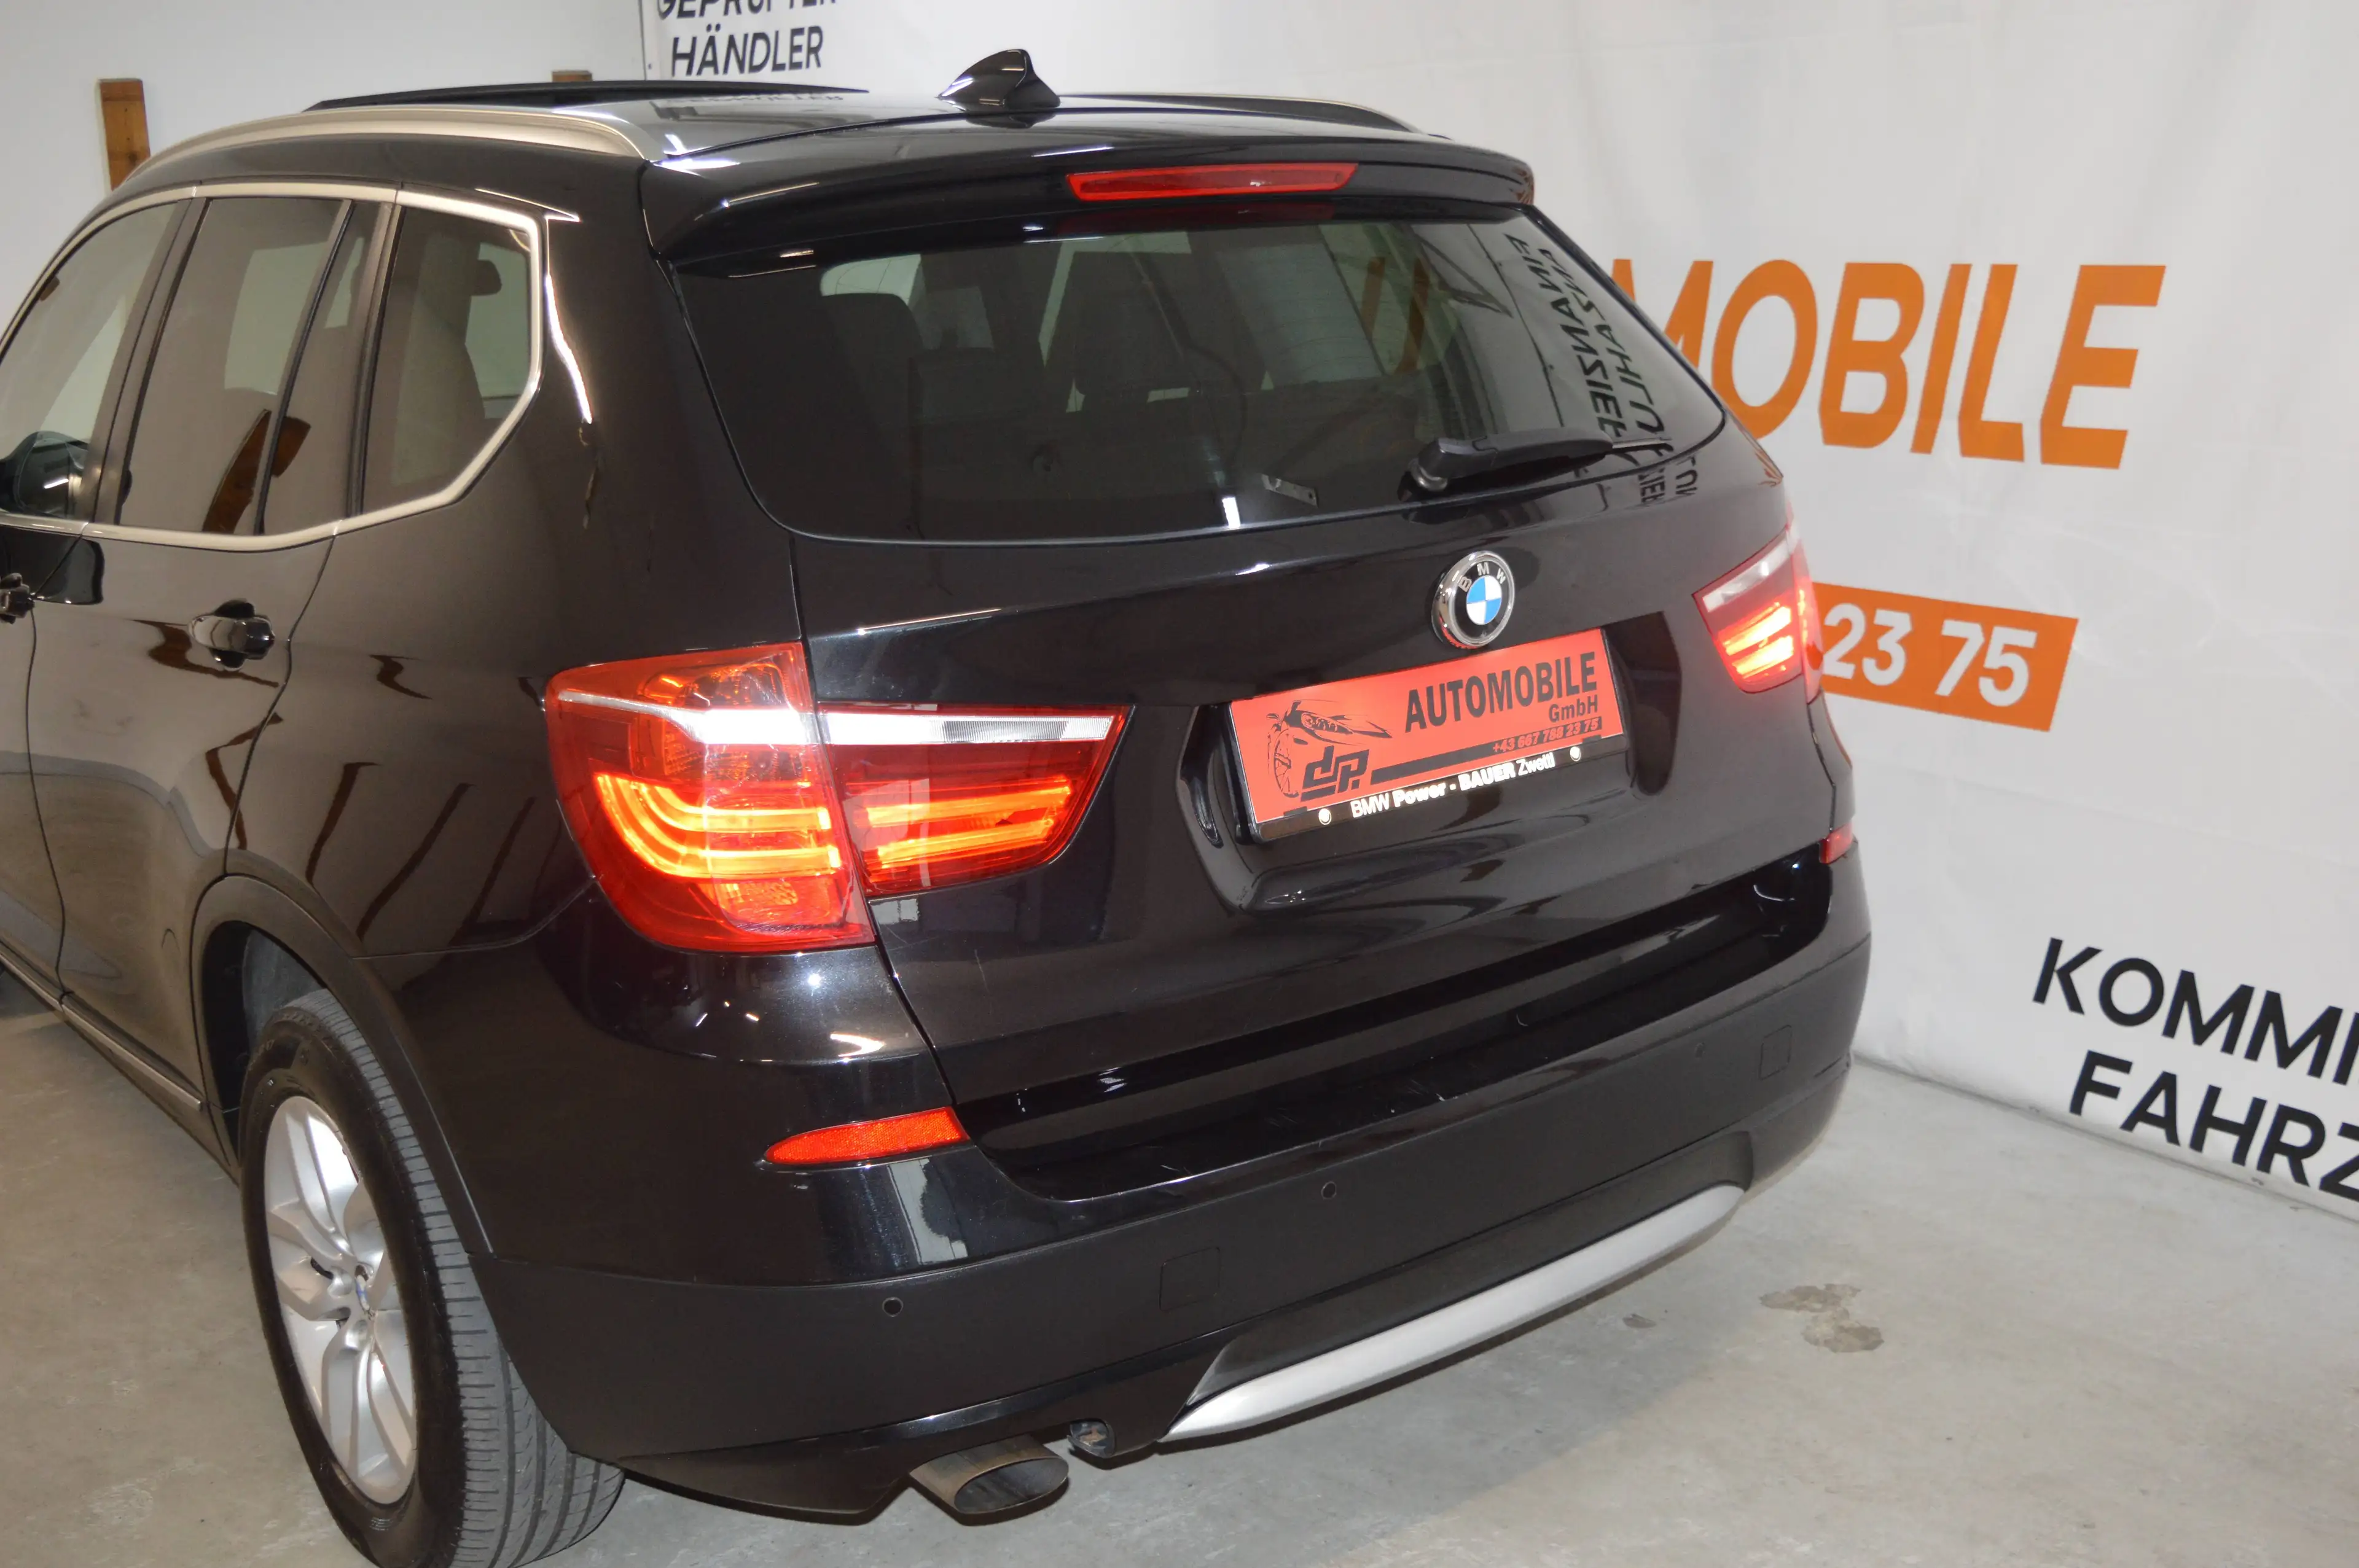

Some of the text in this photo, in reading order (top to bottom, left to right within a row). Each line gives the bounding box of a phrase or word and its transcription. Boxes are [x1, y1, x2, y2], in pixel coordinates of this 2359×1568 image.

[671, 24, 824, 77] HÄNDLER
[1458, 561, 1506, 593] BMW
[1823, 603, 2038, 707] 23 75
[1404, 651, 1598, 733] AUTOMOBILE
[1549, 694, 1598, 723] GmbH
[1493, 738, 1515, 752] +43
[1517, 731, 1541, 749] 667
[1566, 720, 1581, 736] 23
[1584, 716, 1599, 731] 75
[1350, 792, 1390, 819] BMW
[1391, 782, 1447, 808] Power
[1457, 762, 1516, 791] BAUER
[1516, 752, 1556, 776] Zwettl
